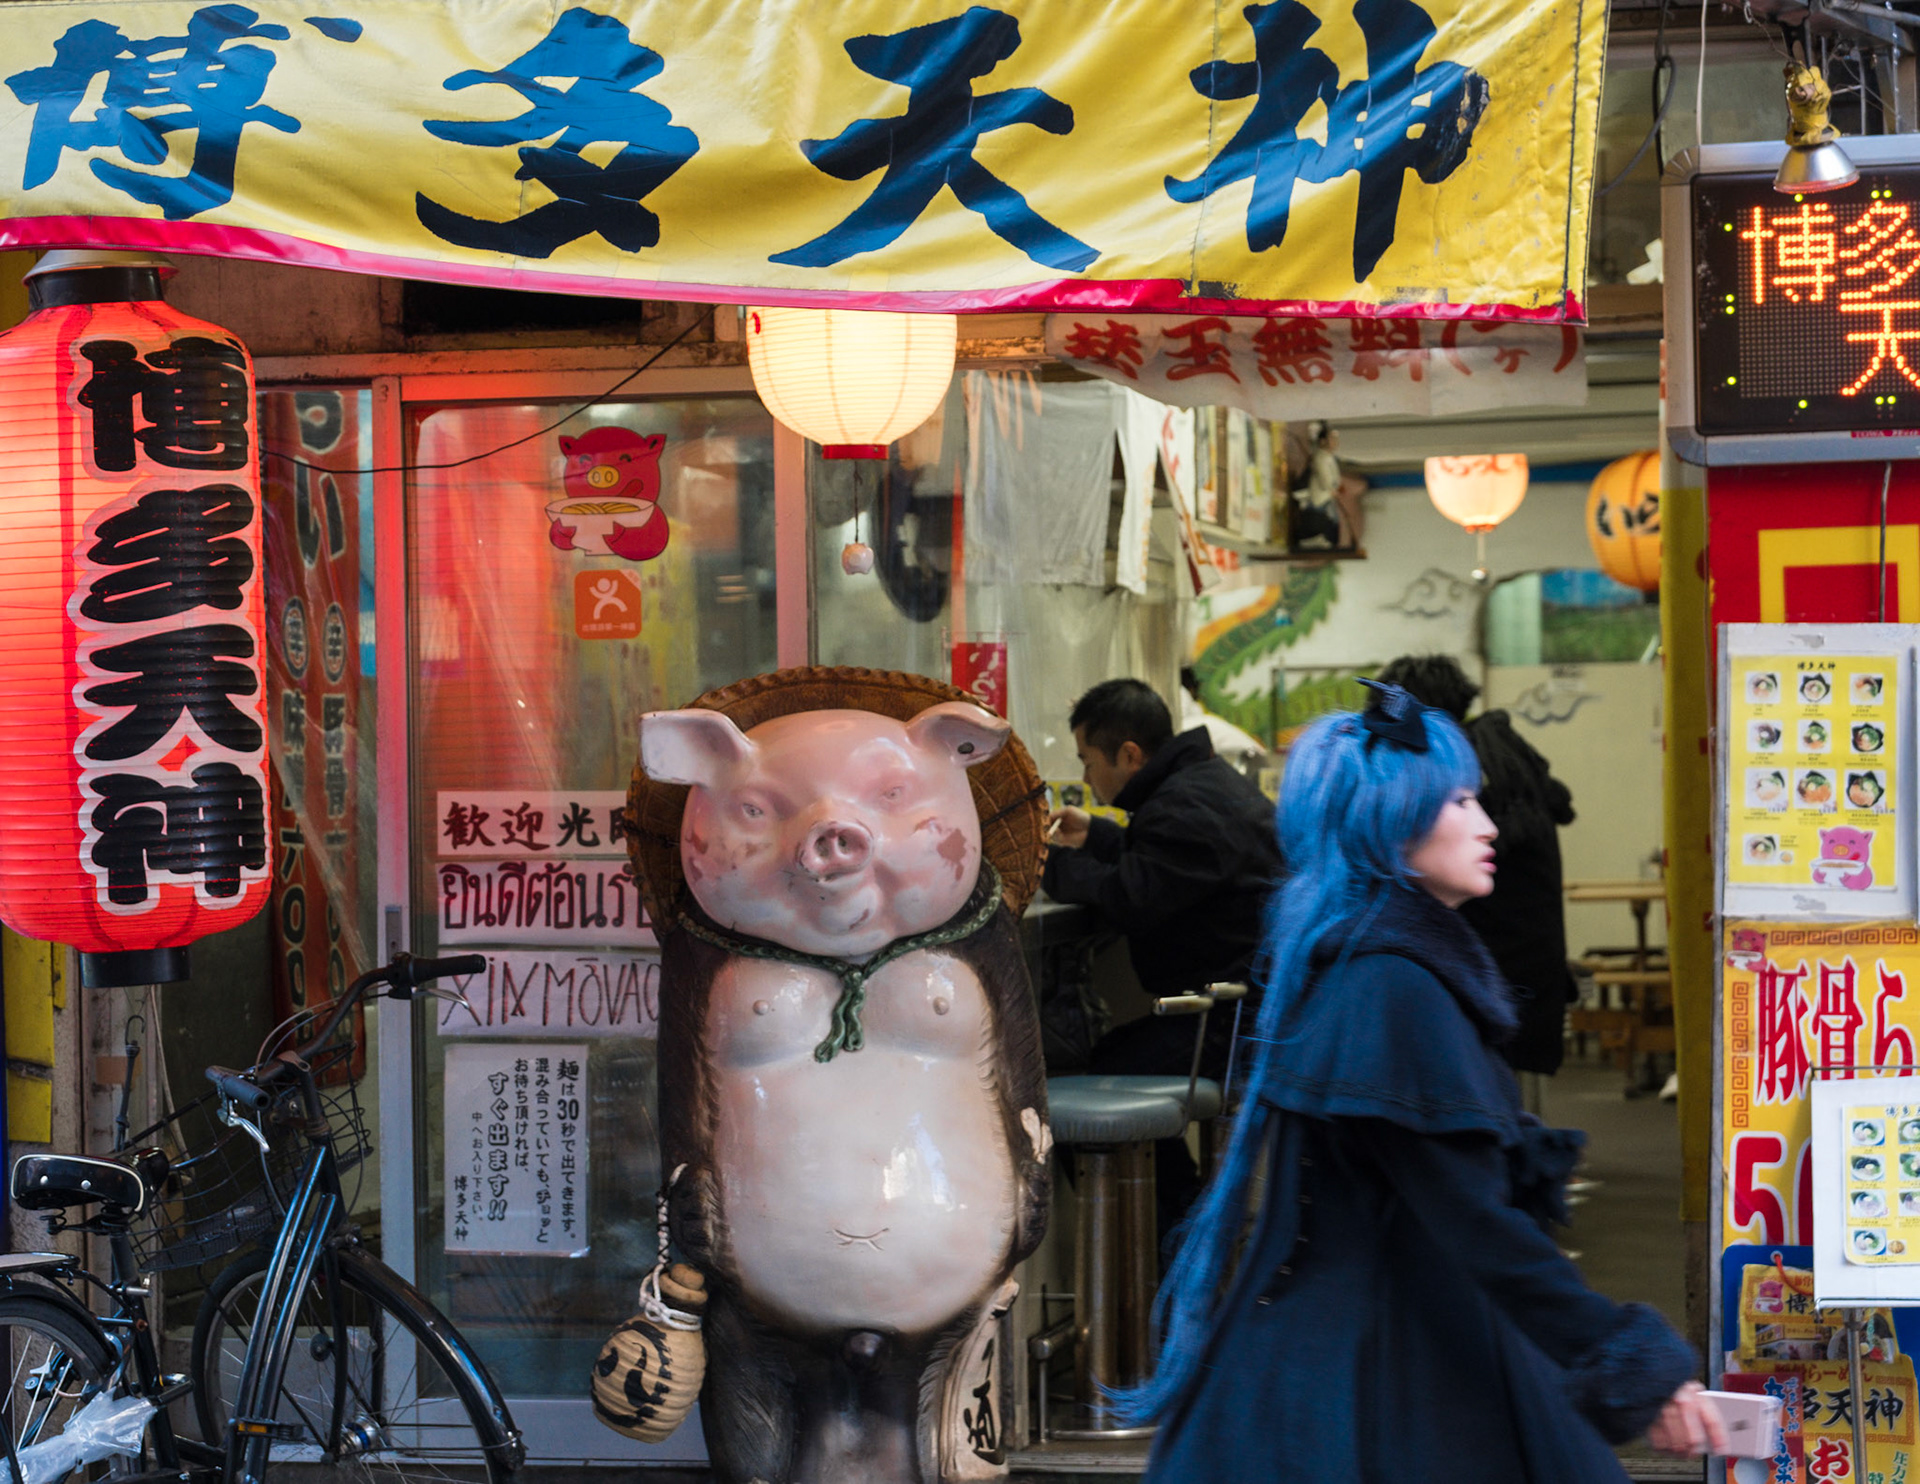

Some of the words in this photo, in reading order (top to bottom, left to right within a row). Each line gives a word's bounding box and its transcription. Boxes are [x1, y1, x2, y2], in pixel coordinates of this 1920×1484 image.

[4, 2, 1490, 284] 博多天神
[77, 335, 266, 906] 博多天神
[453, 1175, 469, 1242] 博多天神
